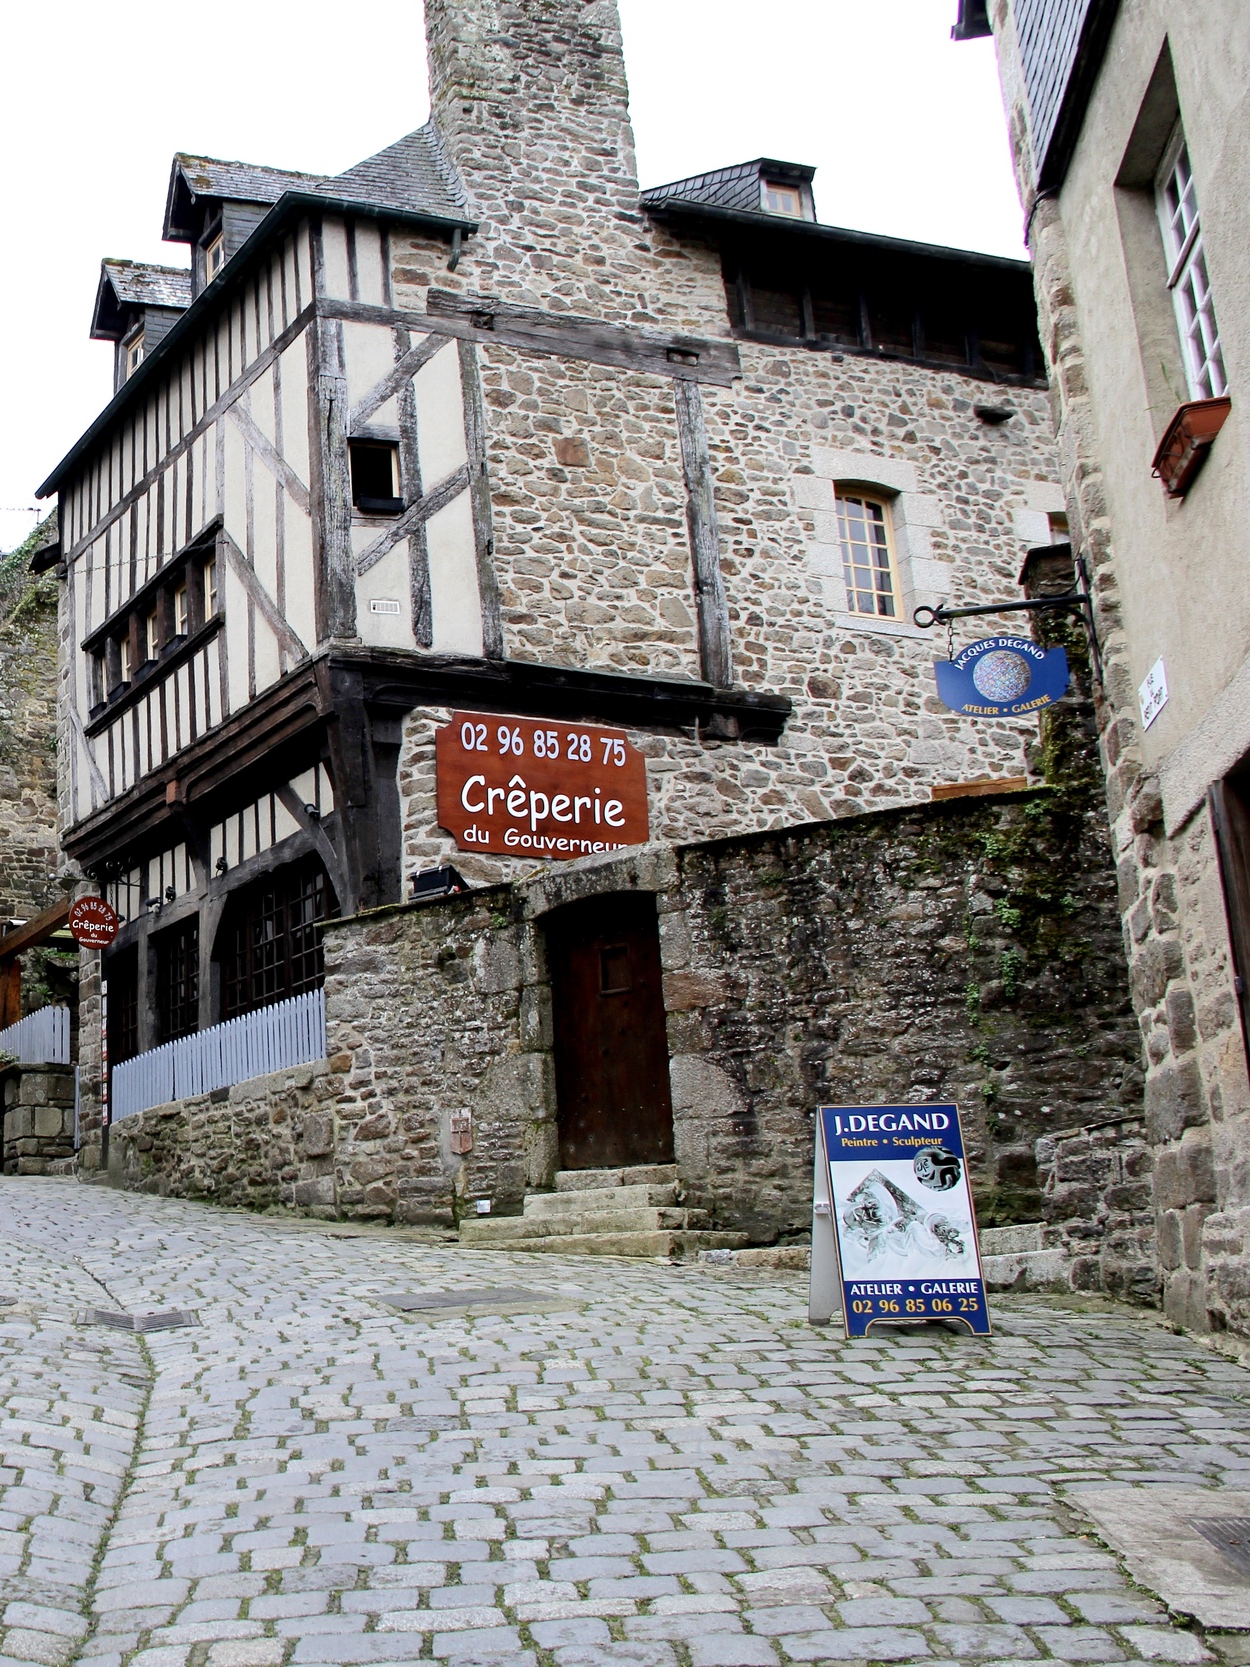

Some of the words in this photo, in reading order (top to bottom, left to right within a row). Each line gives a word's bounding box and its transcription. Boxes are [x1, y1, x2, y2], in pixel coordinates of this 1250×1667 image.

[954, 640, 996, 671] JACQUES
[999, 639, 1045, 660] DEGAND
[961, 704, 999, 714] ATELIER
[1012, 694, 1052, 713] GALERIE
[460, 722, 488, 752] 02
[497, 726, 524, 756] 96
[533, 729, 560, 760] 85
[566, 733, 592, 762] 28
[600, 737, 626, 767] 75
[461, 774, 626, 831] Crêperie
[463, 824, 490, 844] du
[74, 908, 83, 917] 02
[81, 902, 90, 911] 96
[90, 902, 98, 910] 85
[98, 904, 106, 914] 28
[104, 912, 114, 921] 75
[72, 920, 114, 932] Crêperie
[79, 936, 110, 944] Gouverneur
[835, 1112, 950, 1136] J.DEGAND
[841, 1137, 878, 1147] Peintre
[892, 1137, 942, 1147] Sculpteur
[850, 1284, 902, 1295] ATELIER
[921, 1282, 978, 1294] GALERIE
[852, 1299, 873, 1314] 02
[878, 1299, 900, 1313] 96
[906, 1298, 926, 1312] 85
[932, 1298, 952, 1312] 06
[959, 1297, 979, 1312] 25
